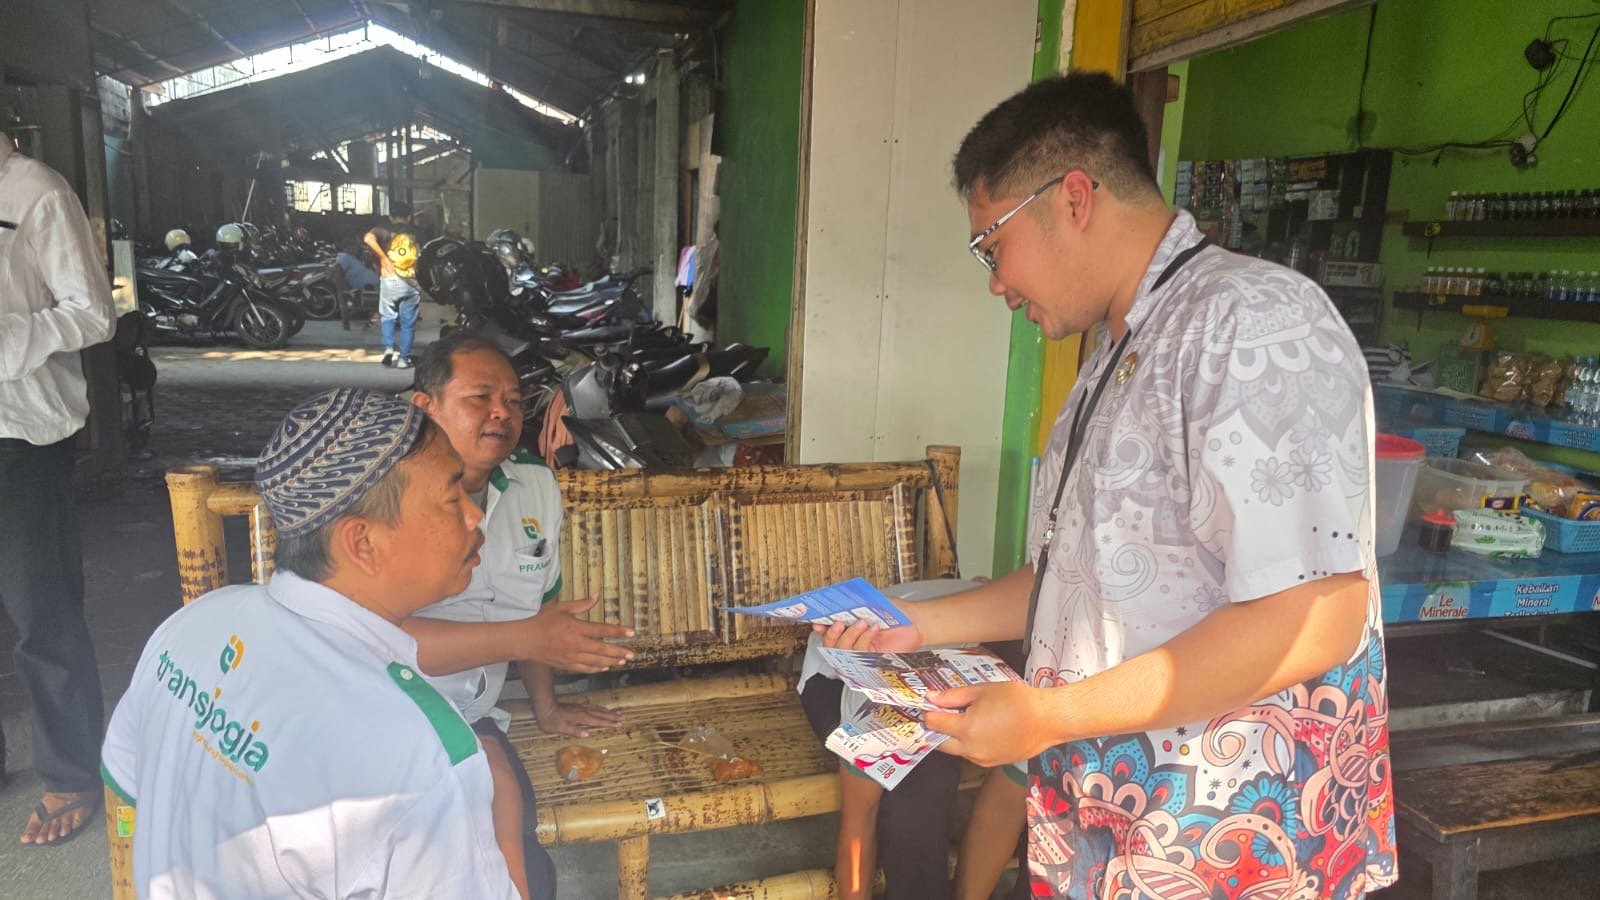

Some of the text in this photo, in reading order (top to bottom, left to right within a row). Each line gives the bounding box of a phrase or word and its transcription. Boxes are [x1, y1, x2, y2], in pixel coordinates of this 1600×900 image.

[1439, 594, 1454, 607] Le
[1516, 596, 1552, 608] Mineral
[1420, 605, 1469, 618] Minerale
[157, 650, 270, 773] transjogja
